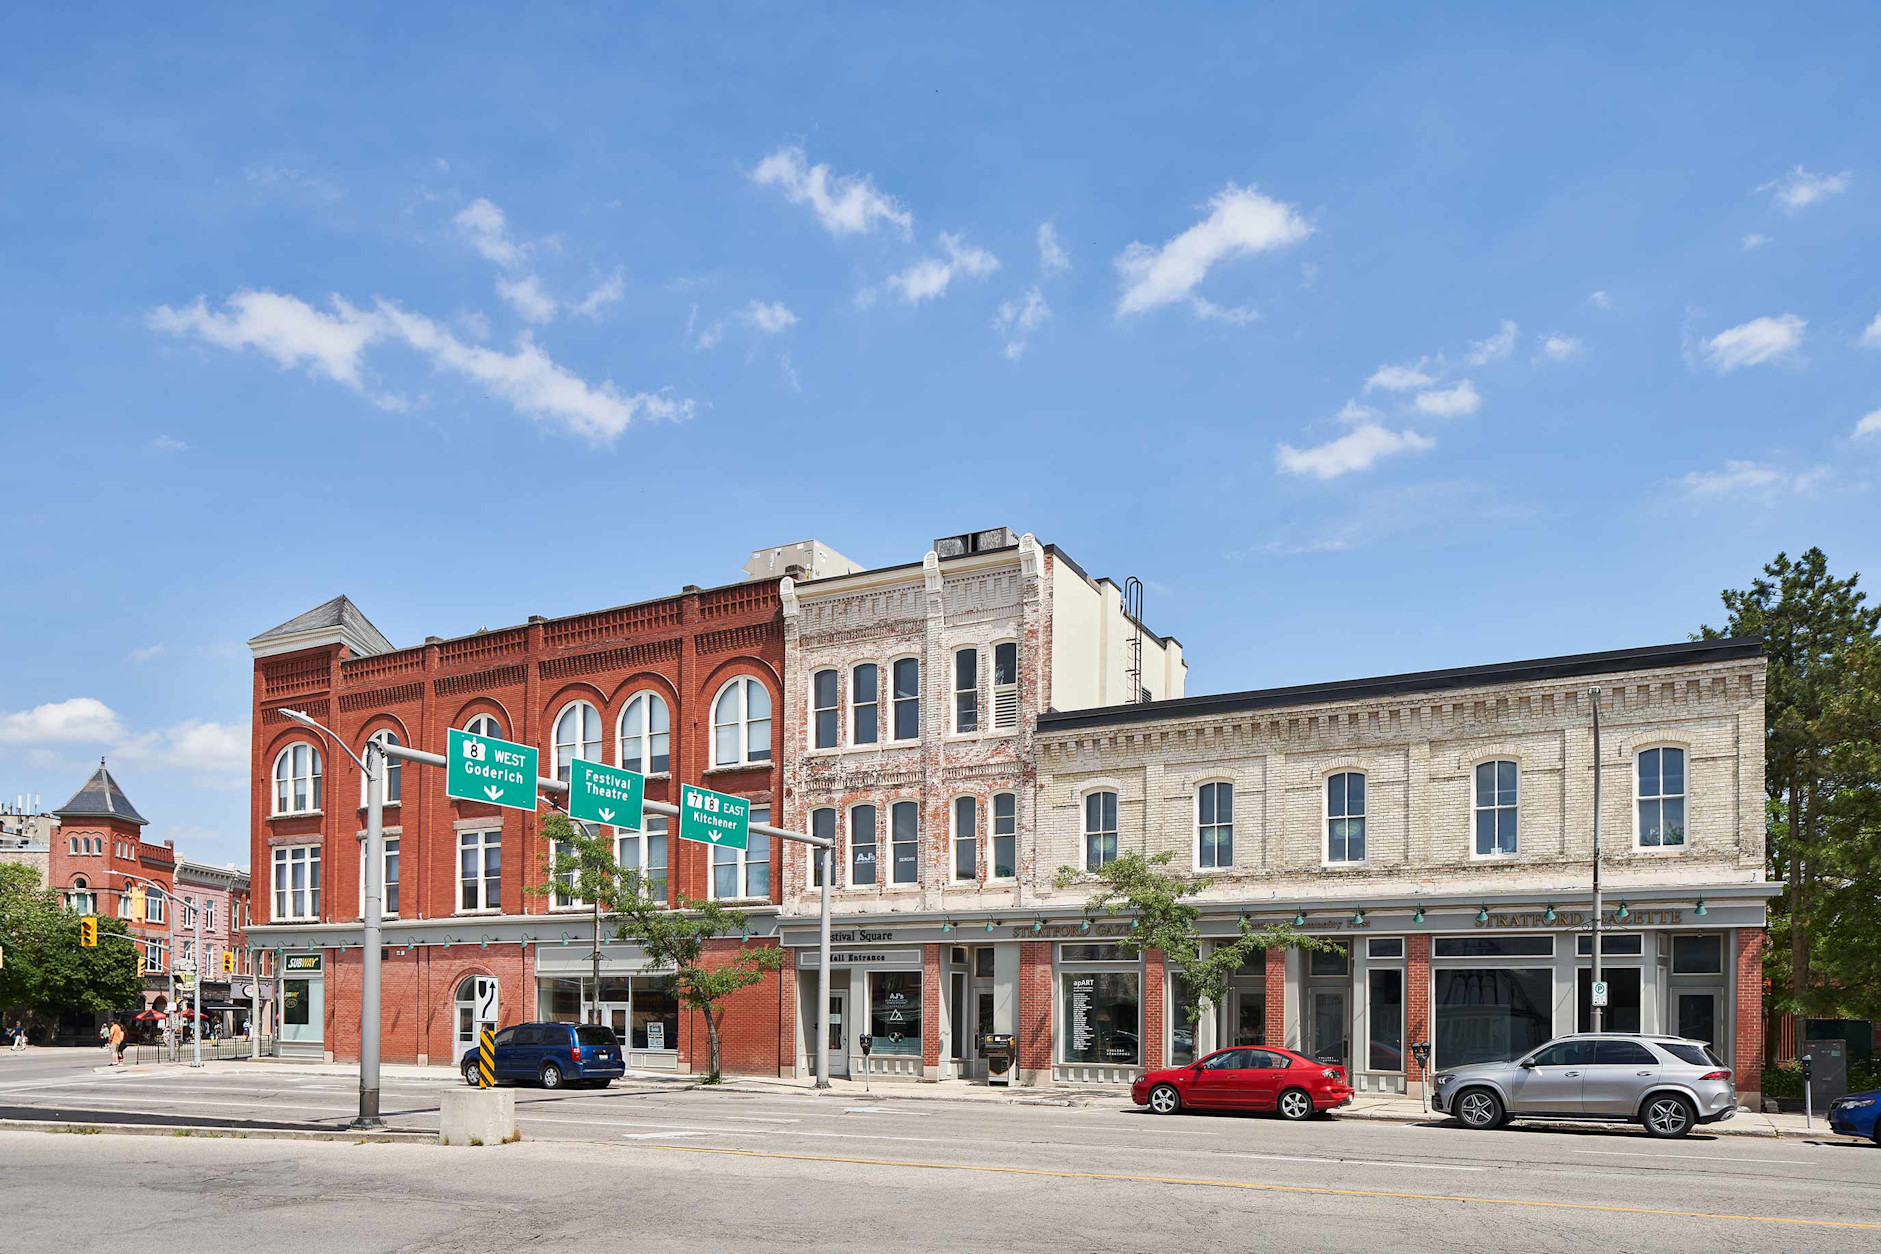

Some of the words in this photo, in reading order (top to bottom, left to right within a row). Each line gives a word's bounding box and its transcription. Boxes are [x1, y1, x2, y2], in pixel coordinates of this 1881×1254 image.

[470, 744, 478, 758] 8
[494, 749, 526, 768] WEST
[465, 761, 523, 784] Goderich
[585, 769, 631, 790] Festival
[585, 781, 629, 801] Theatre
[692, 795, 698, 806] 7
[709, 799, 715, 810] 8
[723, 803, 745, 817] EAST
[693, 811, 737, 830] Kitchener
[856, 852, 876, 862] AJ's
[830, 930, 855, 942] stival
[859, 930, 893, 942] Square
[1012, 925, 1091, 938] STRATFORD
[288, 958, 318, 968] SUBWAY
[848, 954, 885, 962] Entrance
[889, 992, 905, 1000] AJ's
